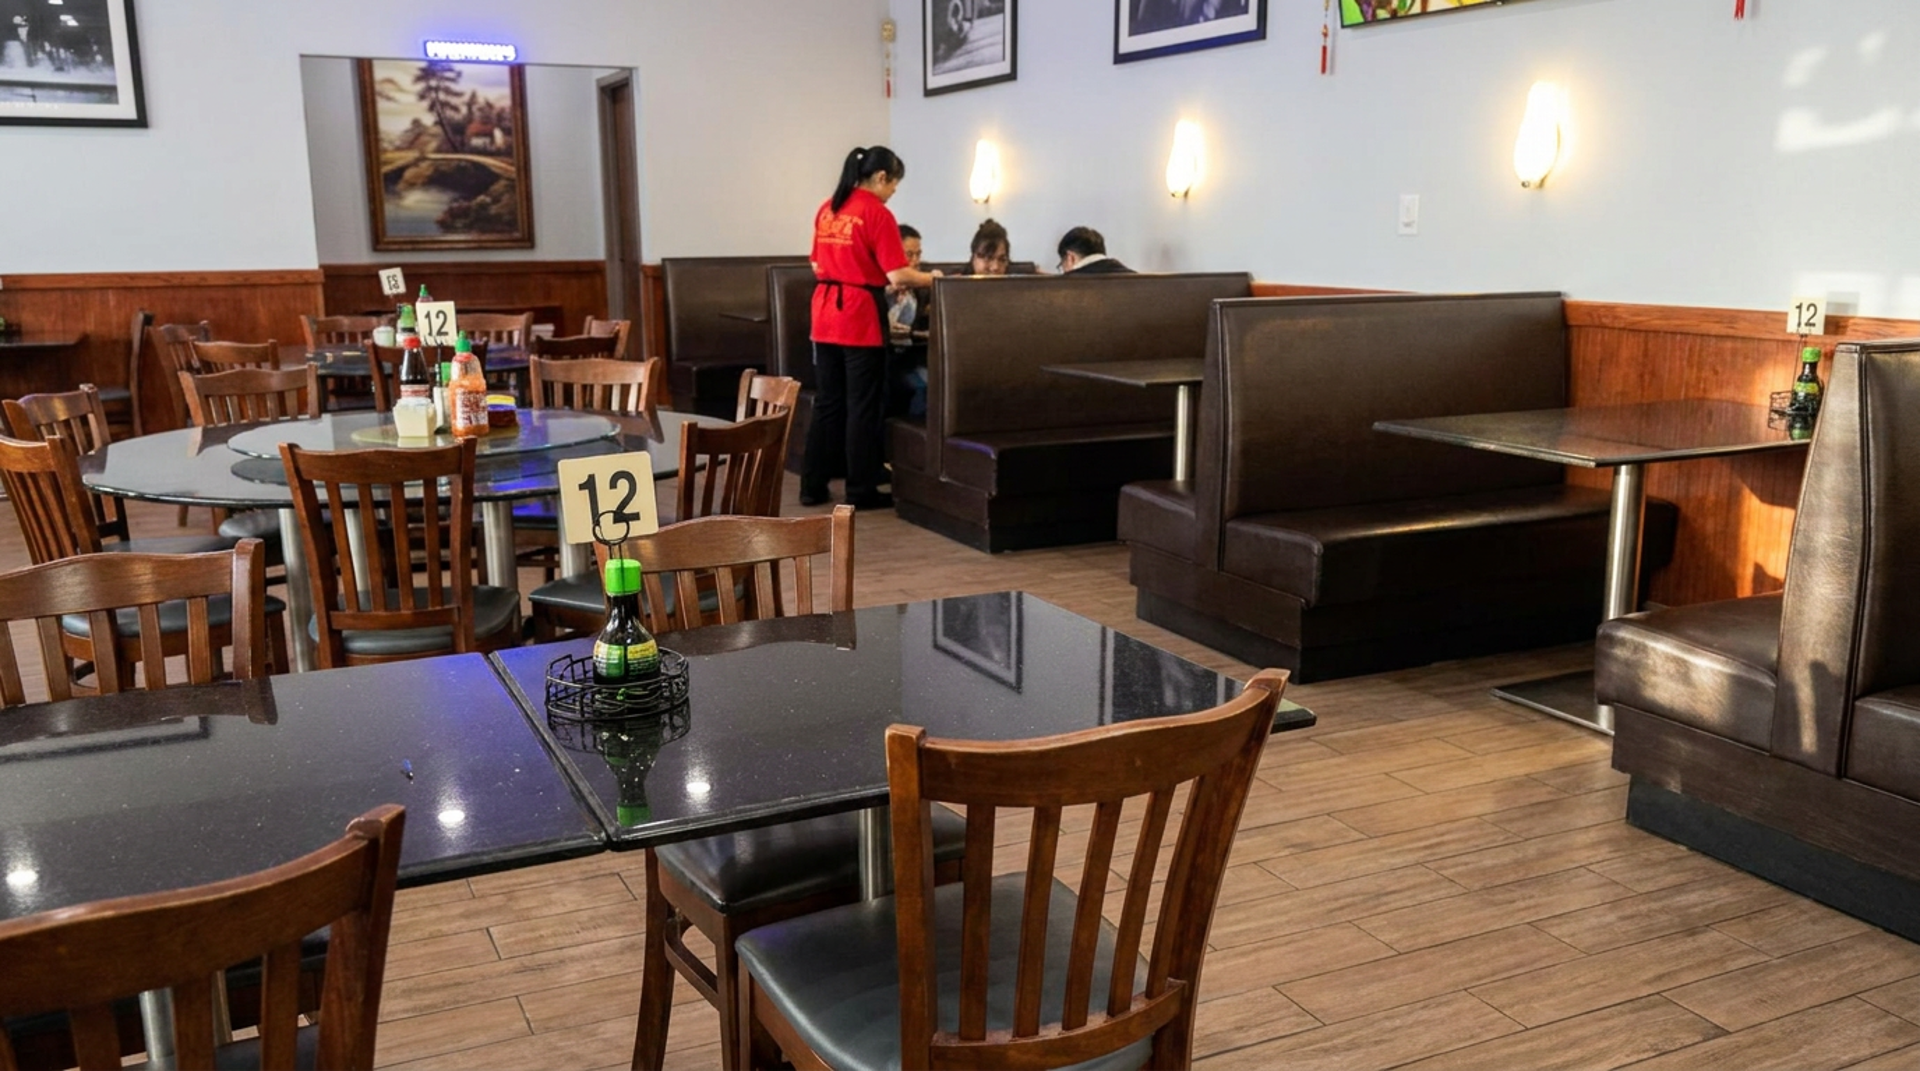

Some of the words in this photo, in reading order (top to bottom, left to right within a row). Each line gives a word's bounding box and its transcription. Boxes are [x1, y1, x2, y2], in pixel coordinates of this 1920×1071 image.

[424, 309, 449, 337] 12
[1795, 302, 1818, 328] 12
[578, 470, 641, 526] 12
